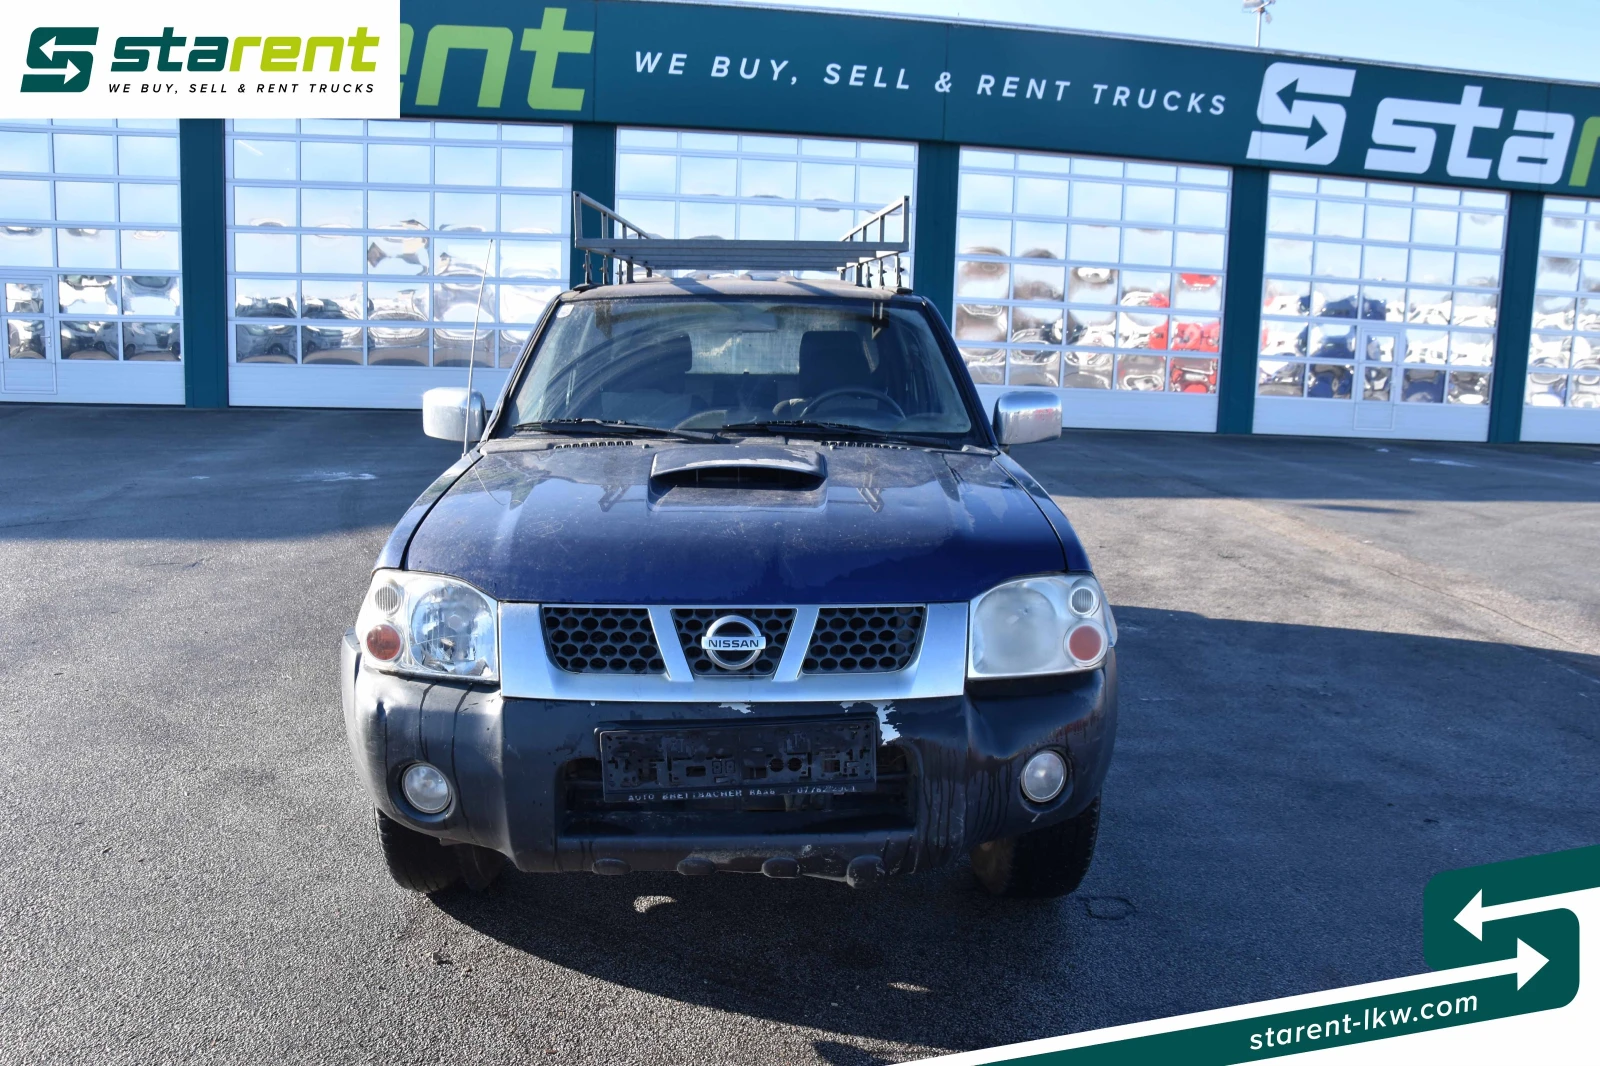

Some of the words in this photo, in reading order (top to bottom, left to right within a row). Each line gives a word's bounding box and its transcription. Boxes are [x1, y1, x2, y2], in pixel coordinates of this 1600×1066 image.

[635, 51, 688, 75] WE
[711, 55, 797, 85] BUY,
[823, 63, 910, 90] SELL
[934, 71, 952, 93] &
[976, 74, 1071, 102] RENT
[1093, 83, 1227, 116] TRUCKS
[708, 639, 759, 648] NISSAN
[627, 793, 655, 801] AUTO
